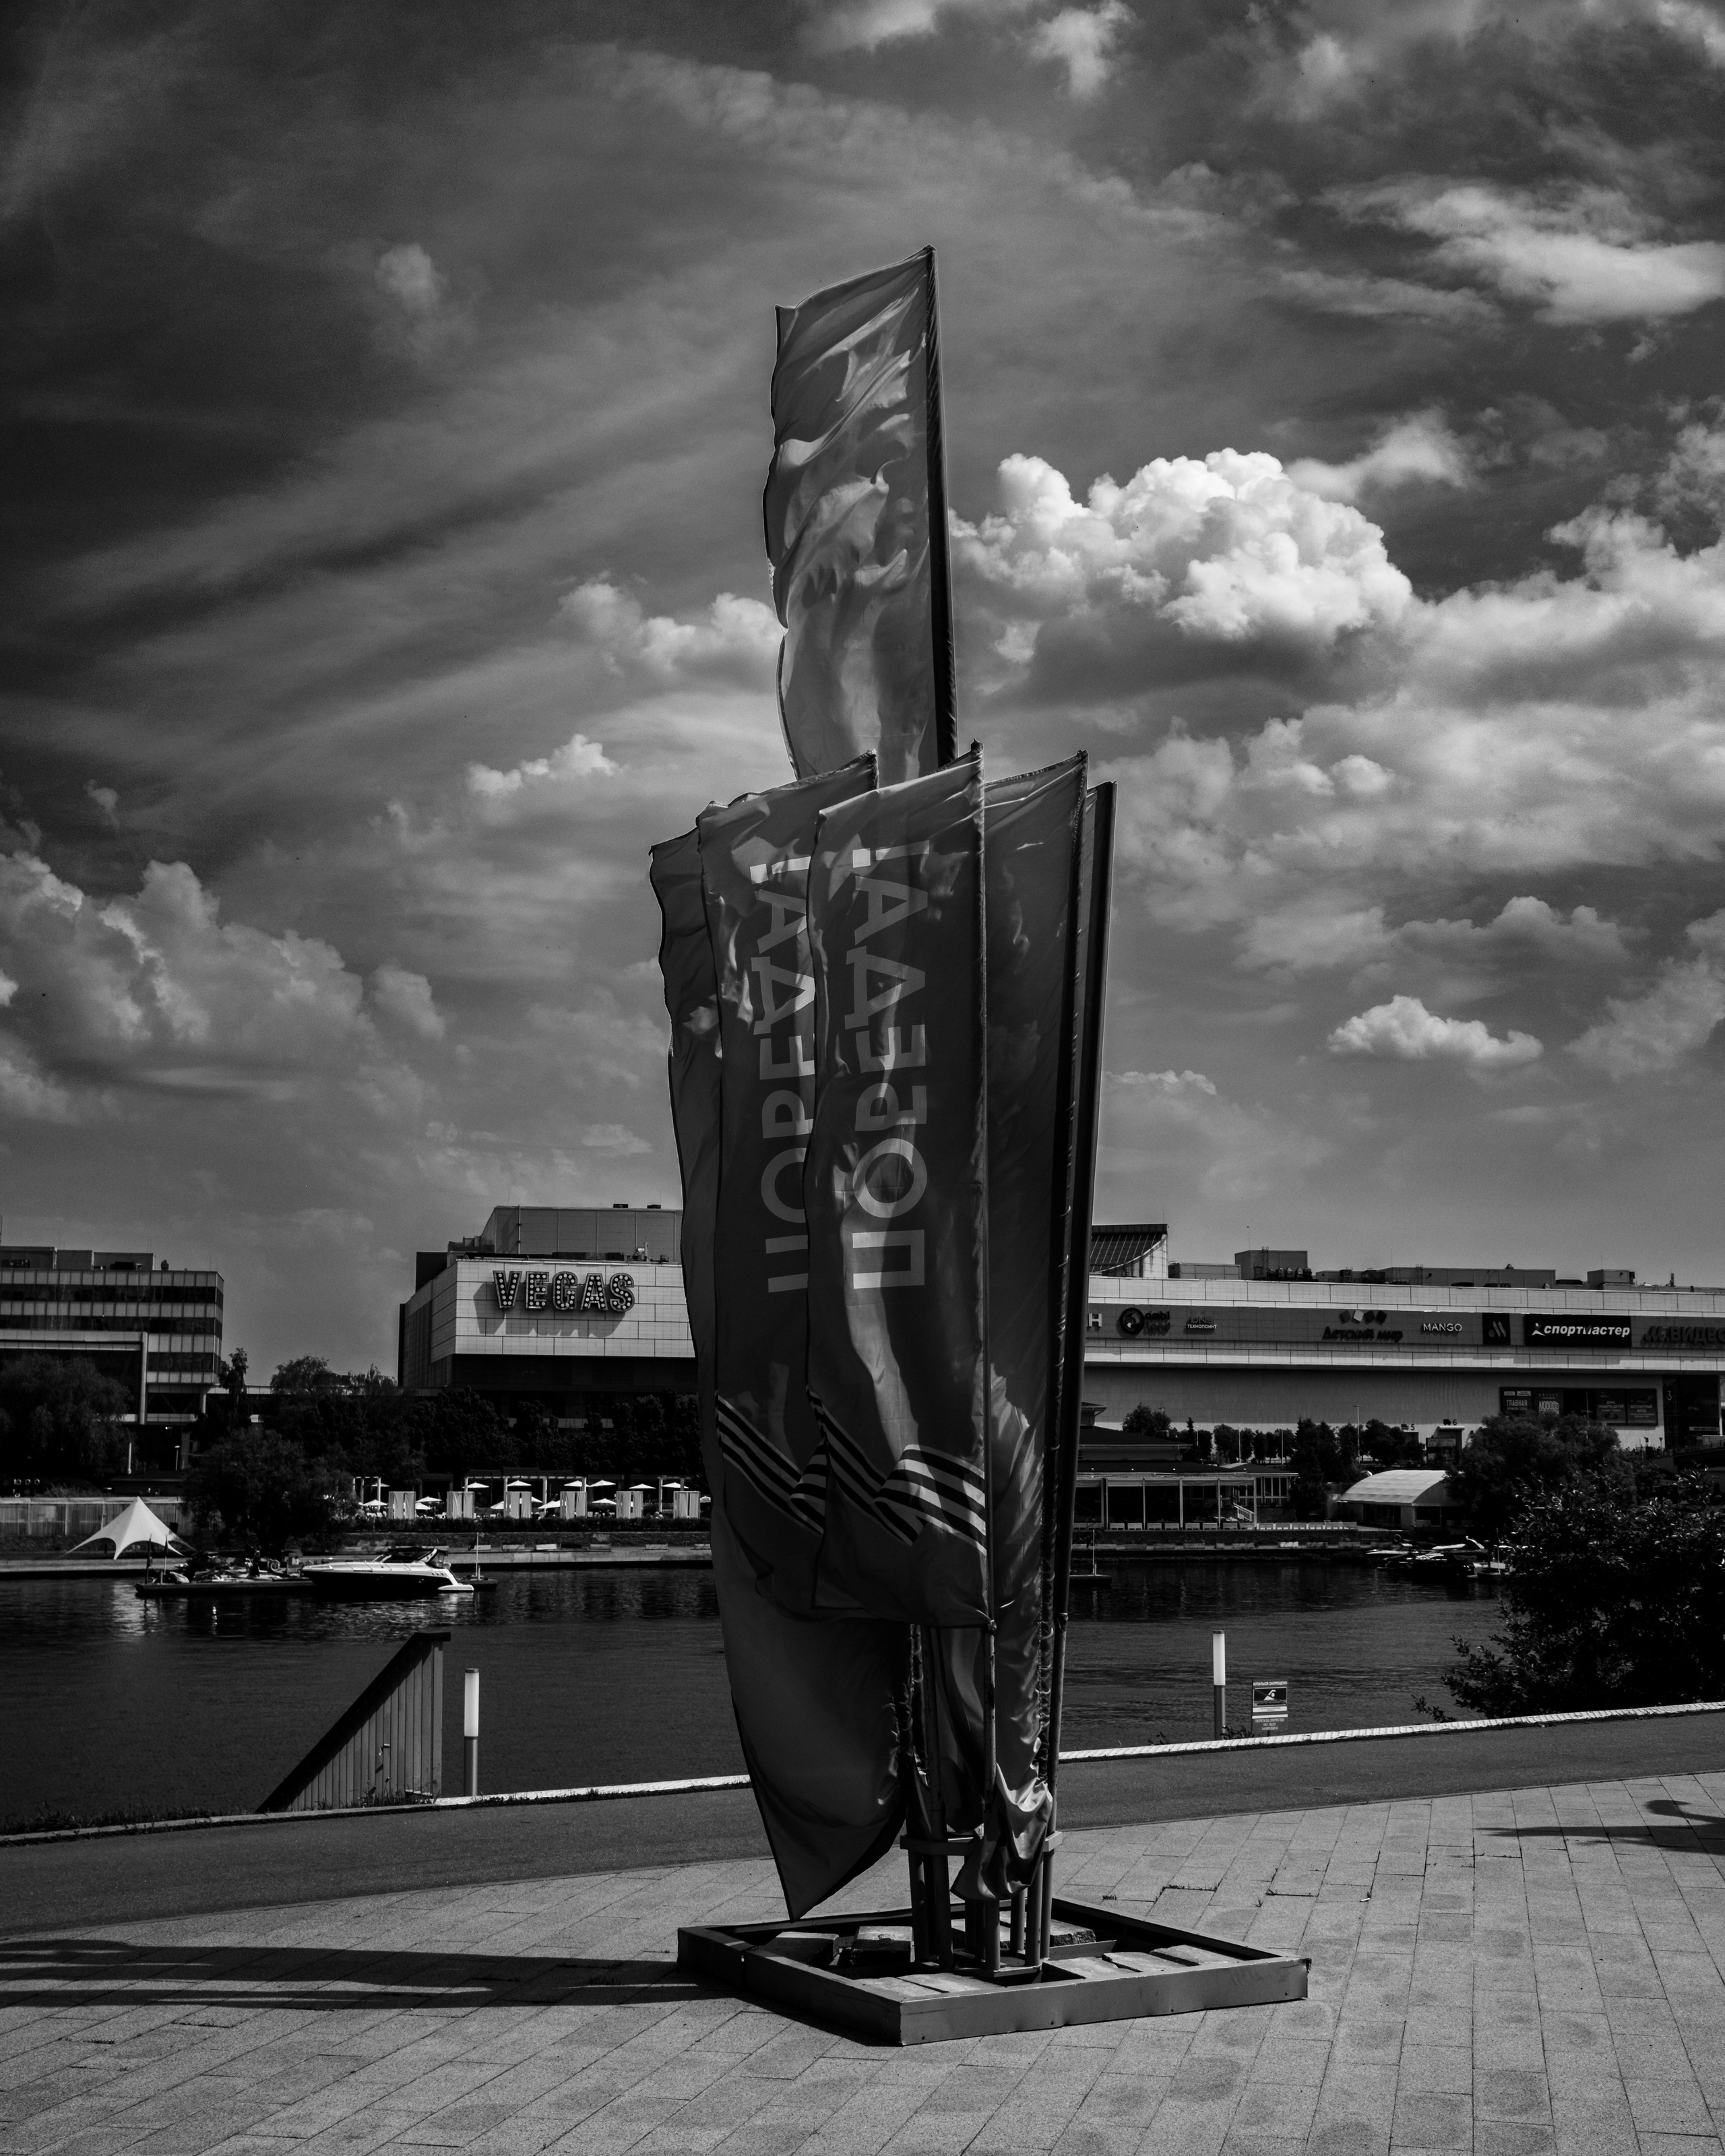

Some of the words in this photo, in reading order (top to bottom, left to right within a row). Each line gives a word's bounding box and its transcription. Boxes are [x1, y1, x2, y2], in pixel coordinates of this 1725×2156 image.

[493, 1271, 635, 1312] VEGAS
[1323, 1326, 1374, 1340] Детский
[1377, 1330, 1403, 1342] мир
[1423, 1323, 1462, 1332] MANGO
[1666, 1390, 1672, 1401] 3
